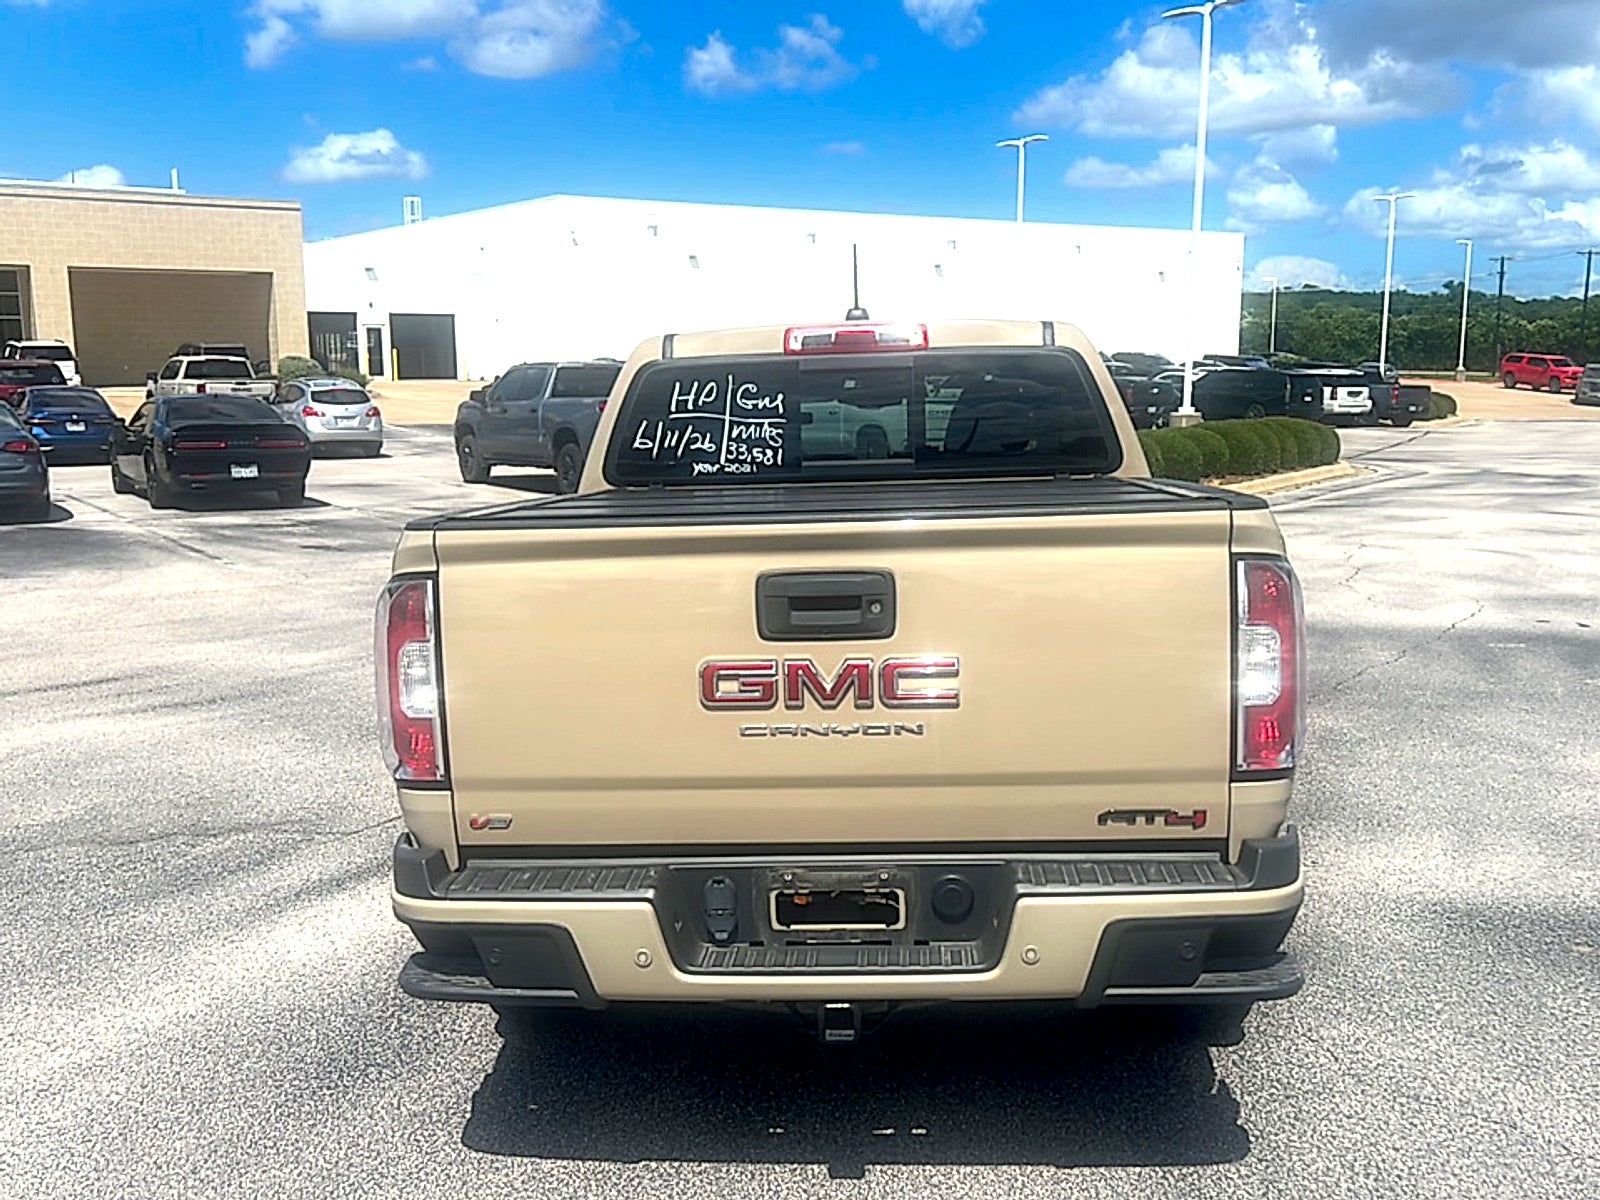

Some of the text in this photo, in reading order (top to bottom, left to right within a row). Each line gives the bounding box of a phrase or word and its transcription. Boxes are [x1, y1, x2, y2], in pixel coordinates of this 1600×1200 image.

[670, 381, 718, 412] HP
[632, 420, 717, 460] 6/11/26
[726, 441, 783, 466] 33,581
[699, 657, 961, 711] GMC
[739, 722, 924, 737] CANYON
[1097, 808, 1207, 831] AT4
